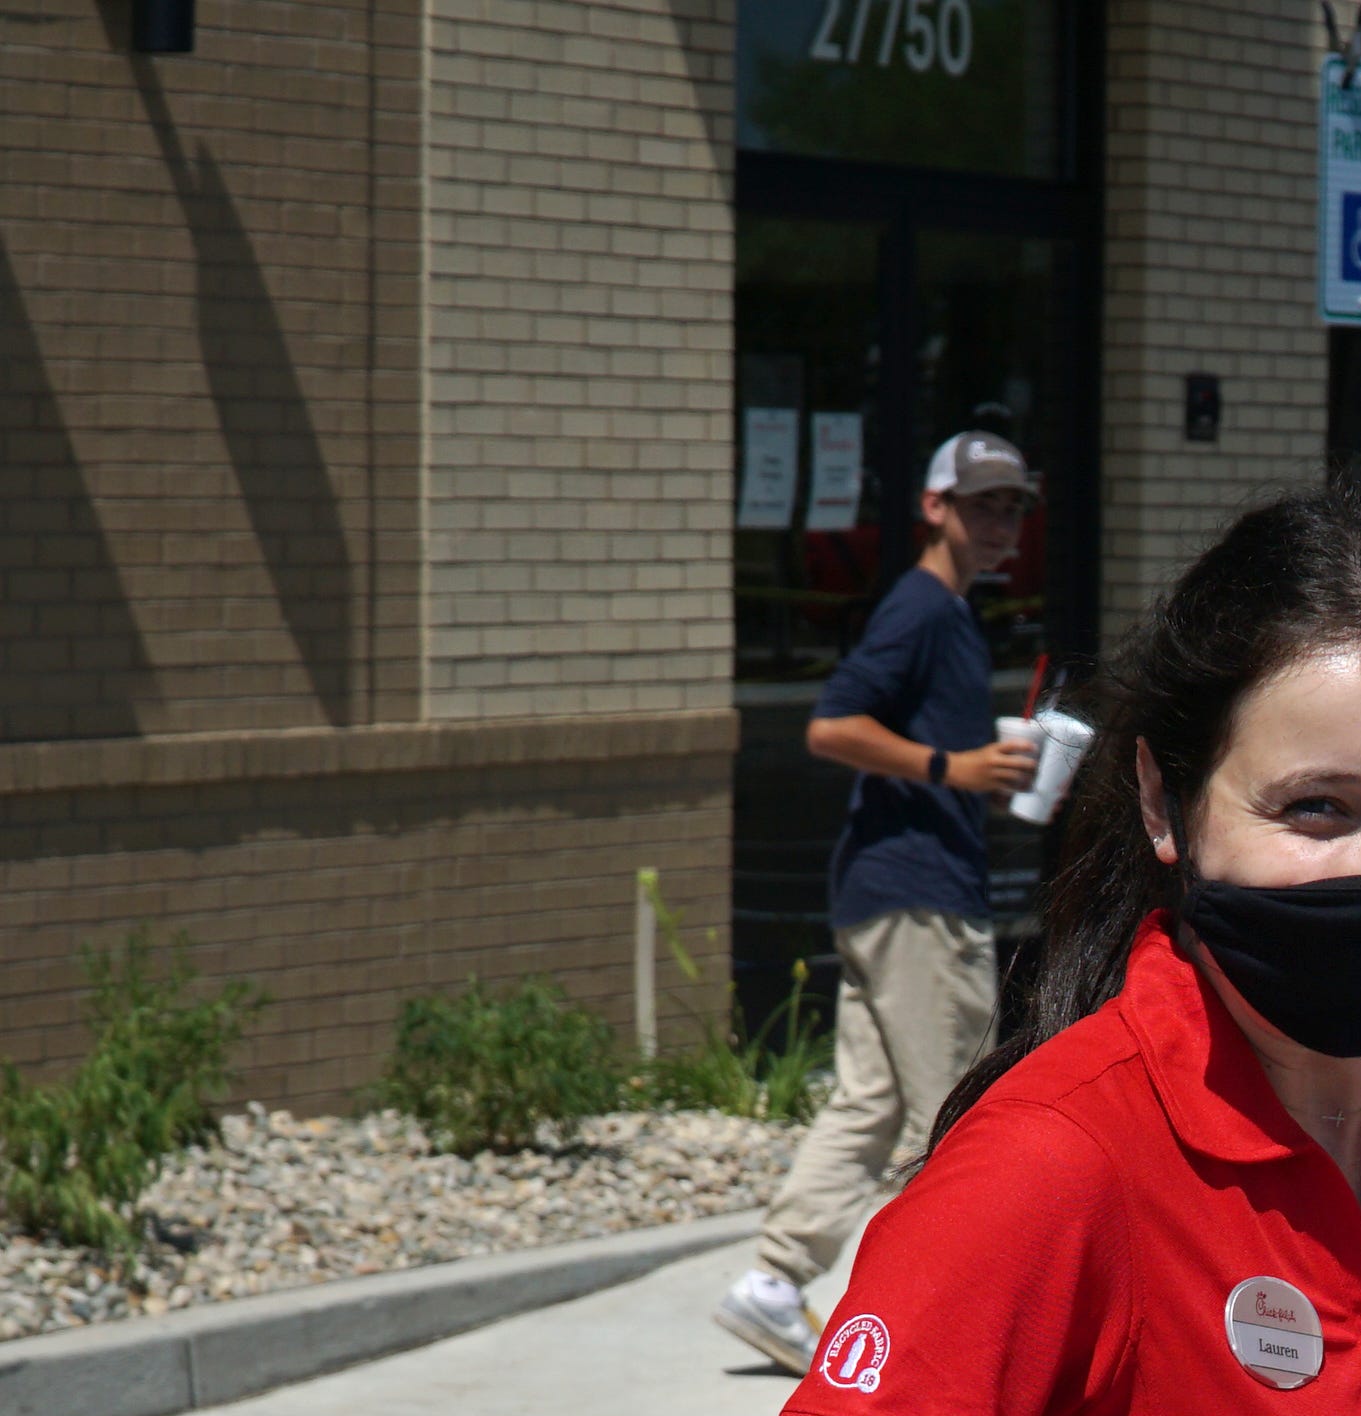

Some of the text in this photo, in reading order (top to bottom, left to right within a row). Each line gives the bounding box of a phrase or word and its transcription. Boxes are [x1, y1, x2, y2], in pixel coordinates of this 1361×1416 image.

[829, 1320, 885, 1367] RECYCLED FABRIC
[1259, 1338, 1299, 1359] Lauren
[860, 1373, 876, 1387] 18
